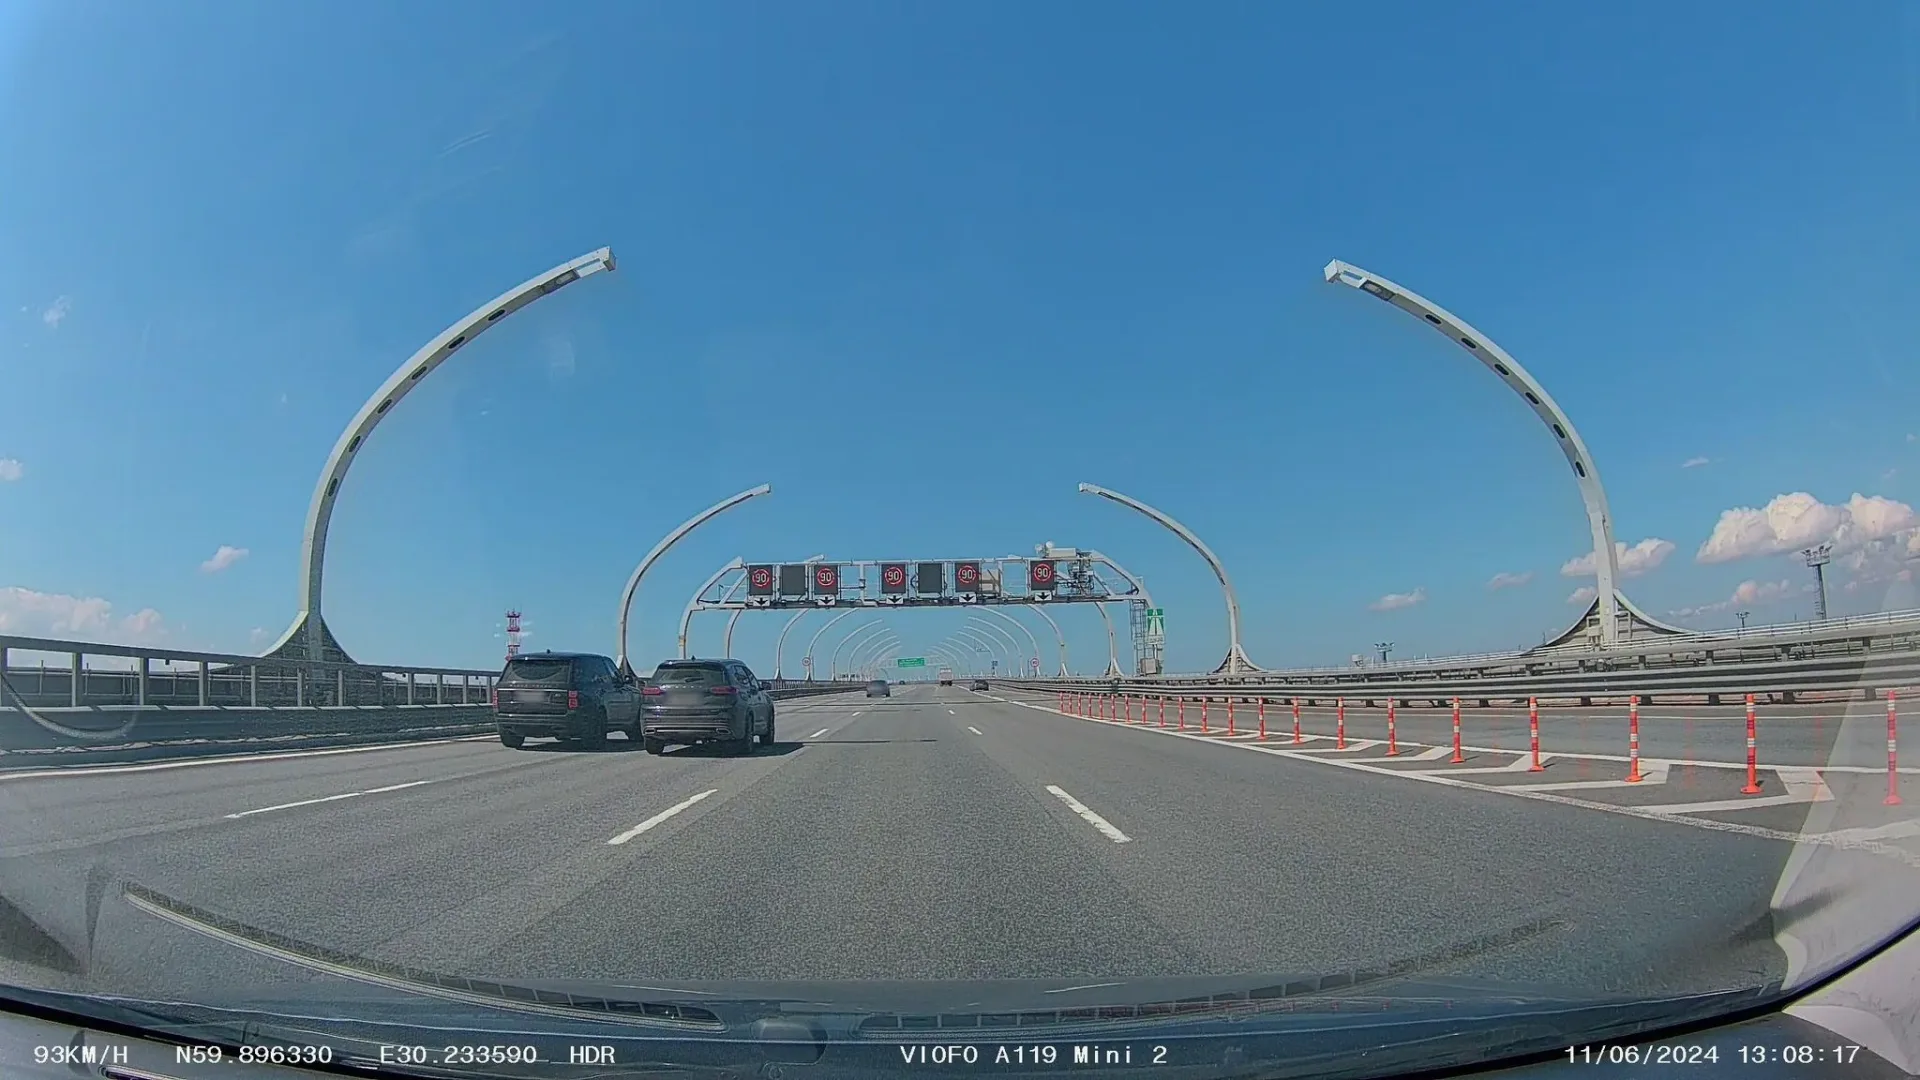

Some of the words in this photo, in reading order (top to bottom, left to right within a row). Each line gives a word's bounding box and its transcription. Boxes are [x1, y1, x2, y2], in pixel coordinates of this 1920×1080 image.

[820, 572, 831, 582] 90
[888, 571, 899, 581] 90
[962, 569, 972, 579] 90
[1038, 567, 1048, 578] 90
[756, 573, 767, 583] 90
